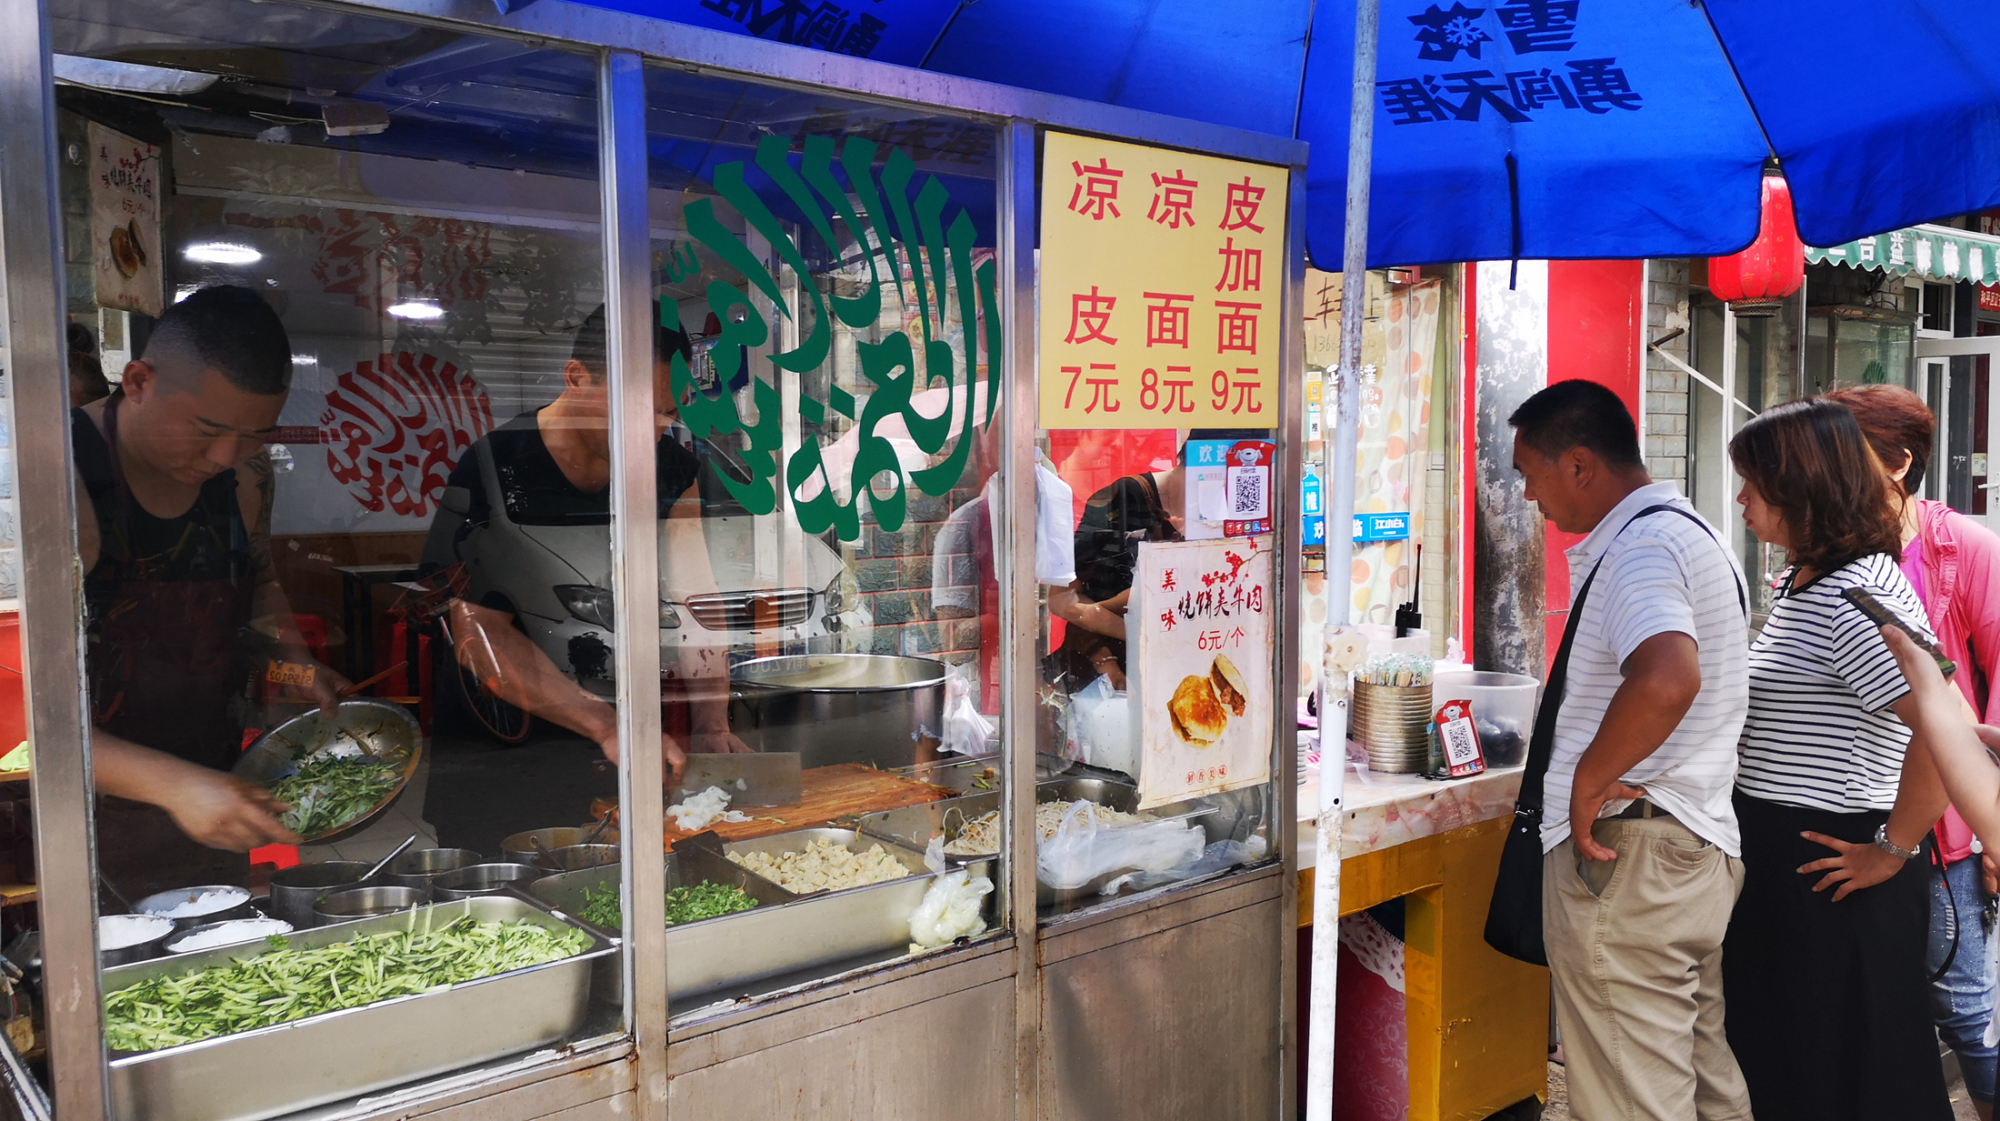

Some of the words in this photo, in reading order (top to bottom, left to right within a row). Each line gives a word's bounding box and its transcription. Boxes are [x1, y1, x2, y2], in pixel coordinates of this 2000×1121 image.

[1060, 363, 1121, 414] 7元
[1139, 365, 1196, 414] 8元
[1211, 368, 1263, 415] 9元
[1178, 583, 1263, 619] 烧饼夹牛肉
[1198, 626, 1245, 651] 6元/个
